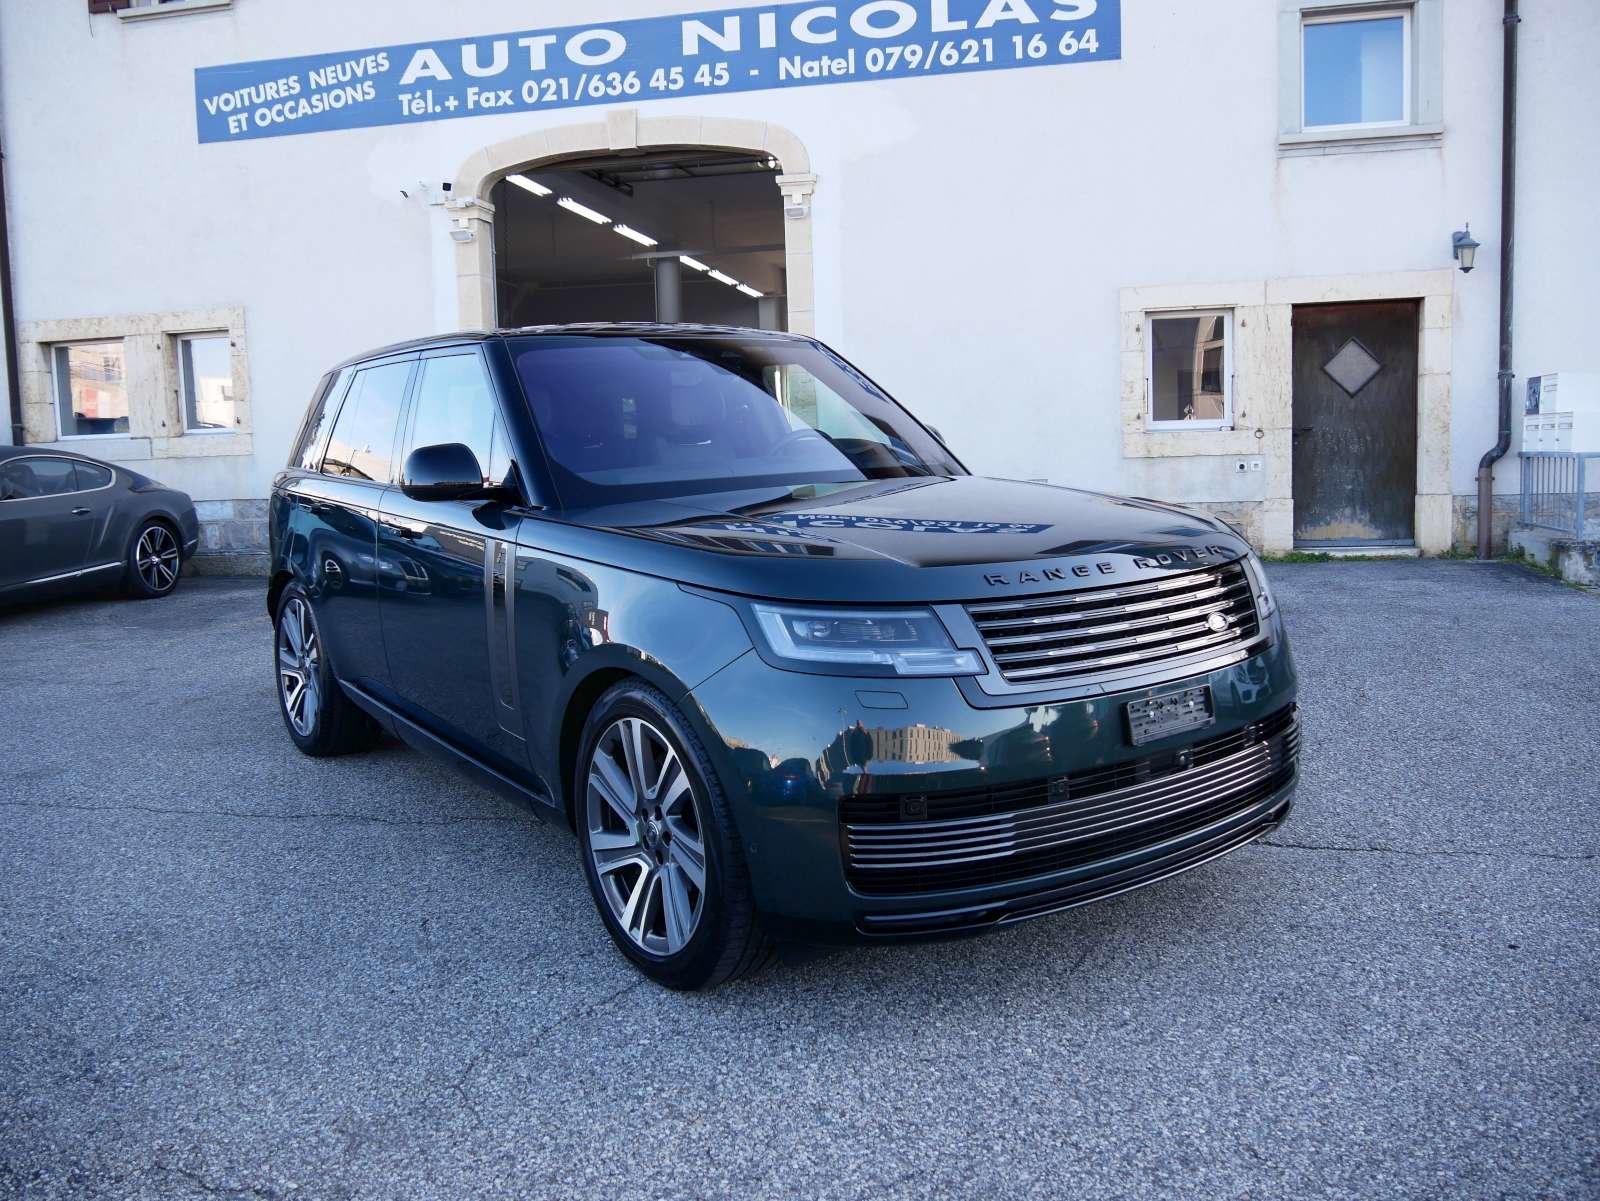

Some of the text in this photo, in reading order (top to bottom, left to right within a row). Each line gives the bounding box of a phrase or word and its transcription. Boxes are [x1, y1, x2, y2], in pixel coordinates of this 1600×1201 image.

[400, 0, 1097, 84] AUTO NICOLAS
[466, 86, 514, 109] Fax
[522, 71, 640, 104] 021/636
[649, 66, 685, 91] 45
[694, 62, 730, 87] 45
[778, 49, 855, 81] Natel
[865, 37, 993, 73] 079/621
[1012, 33, 1048, 60] 16
[1058, 29, 1099, 55] 64
[203, 53, 390, 115] VOITURES NEUVES
[228, 81, 376, 134] ET OCCASIONS
[984, 543, 1223, 586] RANGE ROVER
